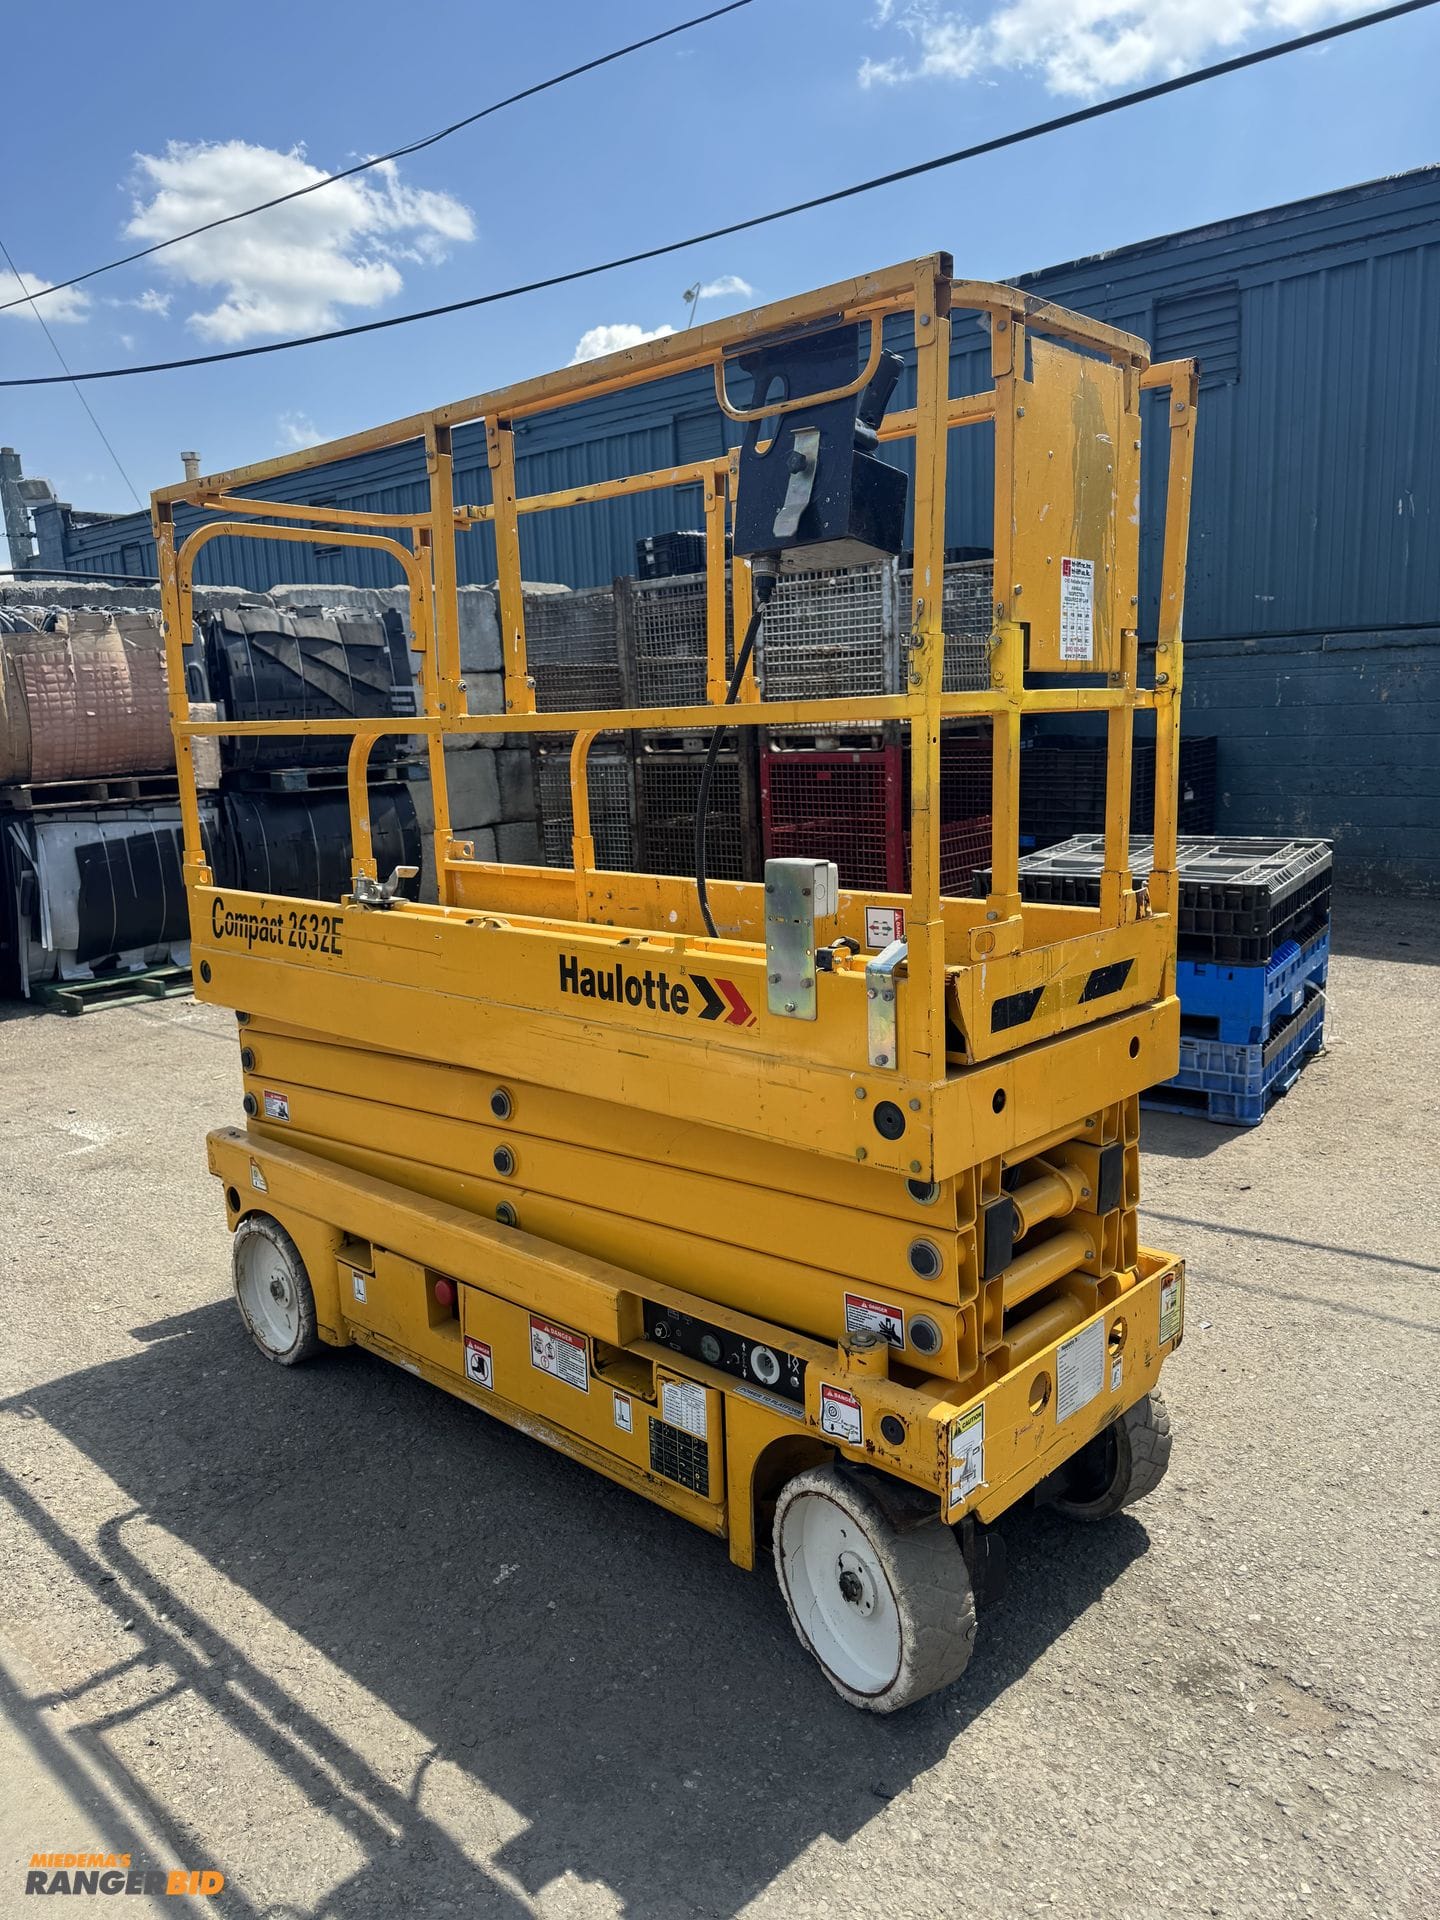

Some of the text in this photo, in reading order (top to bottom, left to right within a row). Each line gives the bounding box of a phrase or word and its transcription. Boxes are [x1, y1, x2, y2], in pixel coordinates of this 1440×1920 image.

[212, 896, 343, 955] Compact 2632E
[559, 953, 690, 1015] Haulotte
[550, 1328, 573, 1342] DANGER
[740, 1387, 762, 1399] POWER
[772, 1399, 804, 1415] PLATFORM
[962, 1412, 982, 1429] CAUTION
